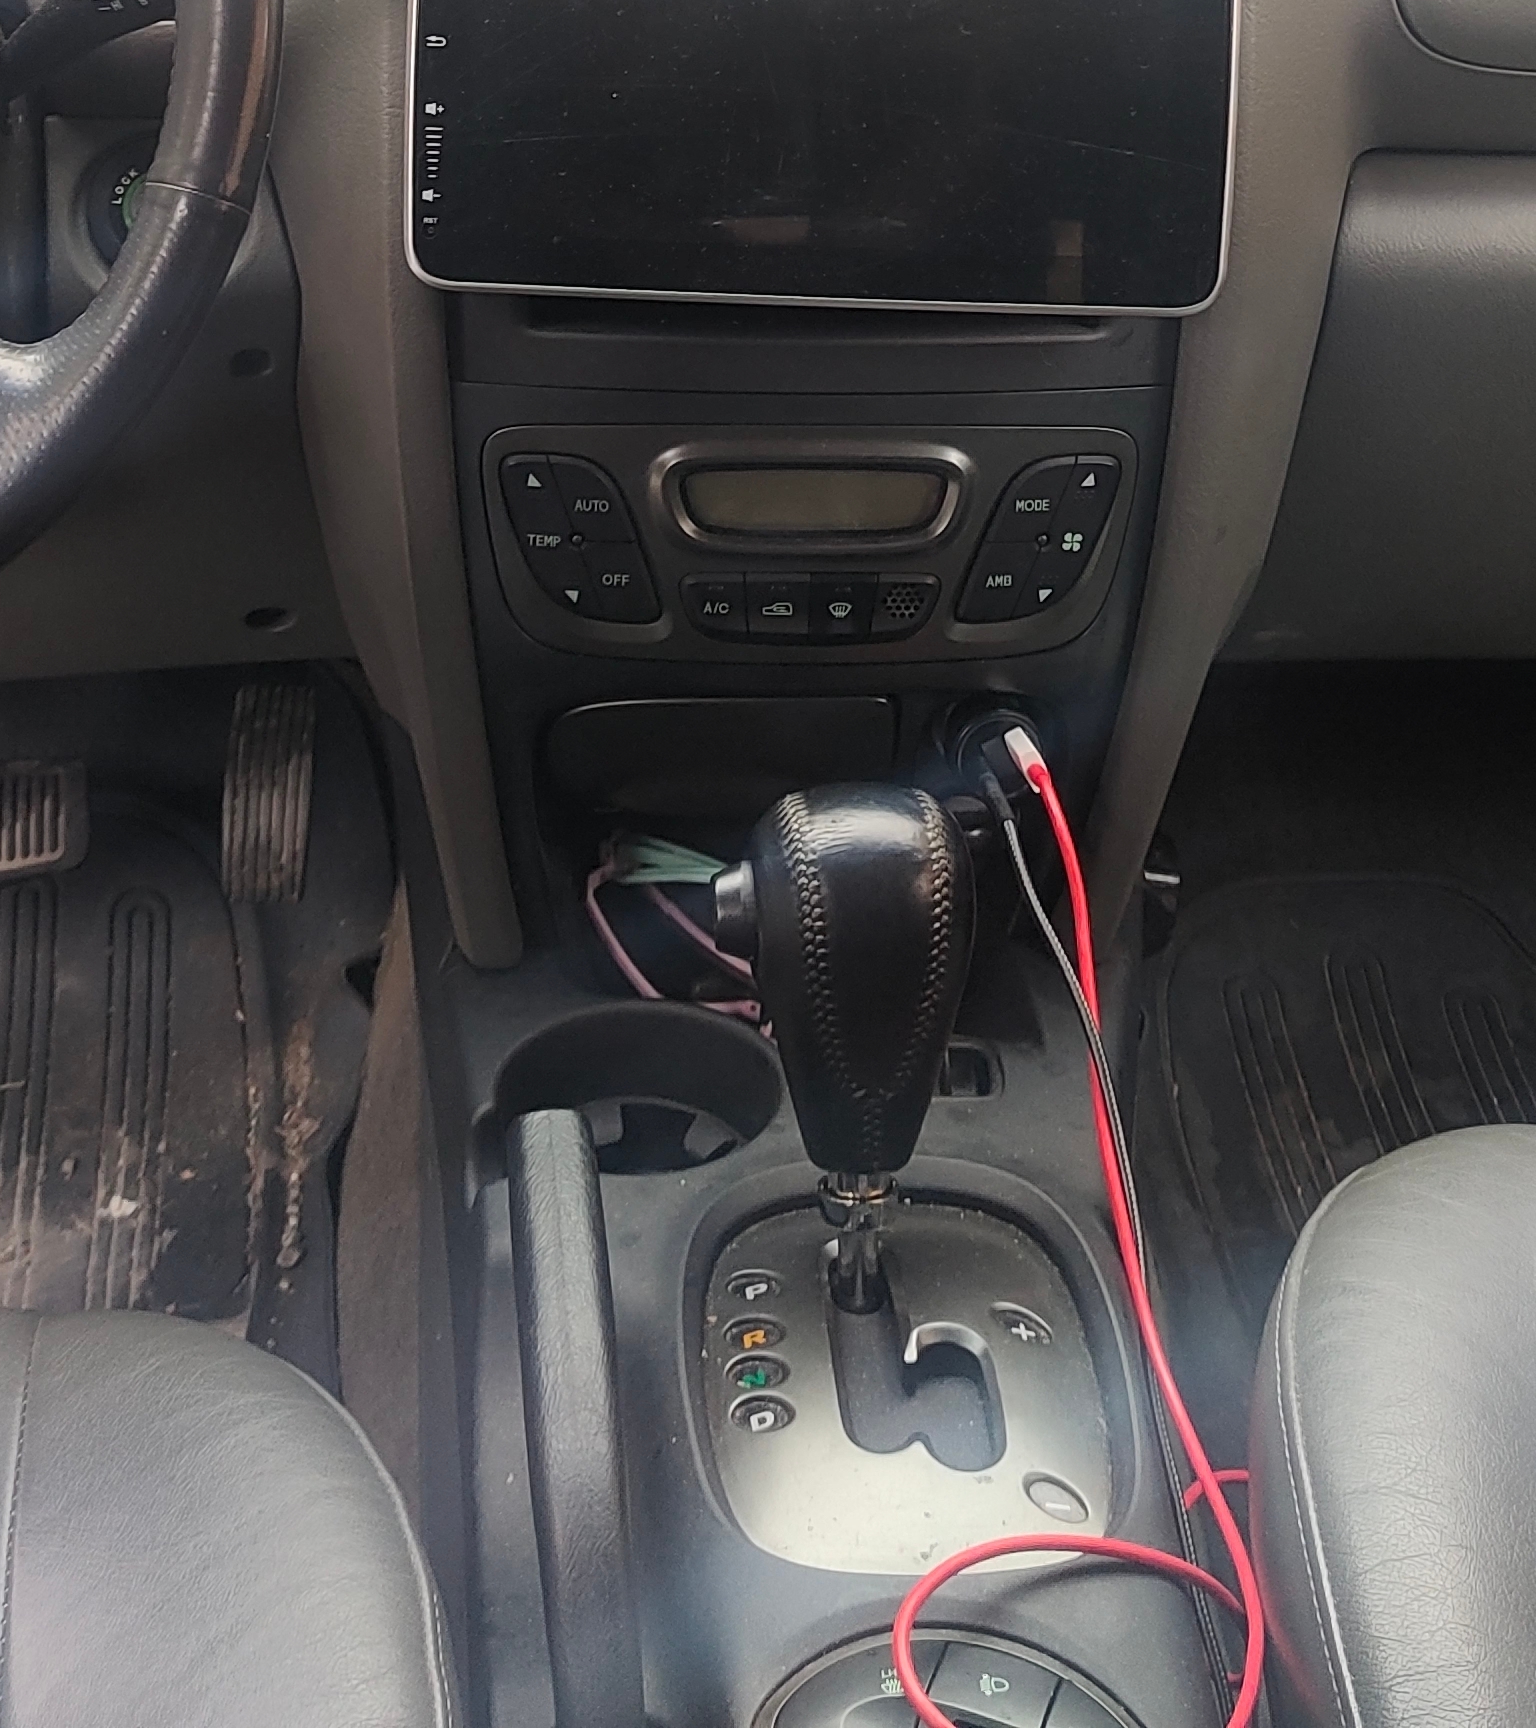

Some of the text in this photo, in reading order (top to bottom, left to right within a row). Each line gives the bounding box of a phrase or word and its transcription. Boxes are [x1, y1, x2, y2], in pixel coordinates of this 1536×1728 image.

[111, 168, 139, 205] LOCK
[574, 499, 610, 513] AUTO
[1015, 499, 1051, 513] MODE
[526, 534, 562, 548] TEMP
[601, 574, 631, 587] OFF
[985, 574, 1013, 588] AMB
[703, 601, 730, 614] A/C
[745, 1283, 769, 1301] P
[743, 1329, 767, 1349] R
[749, 1410, 775, 1433] D
